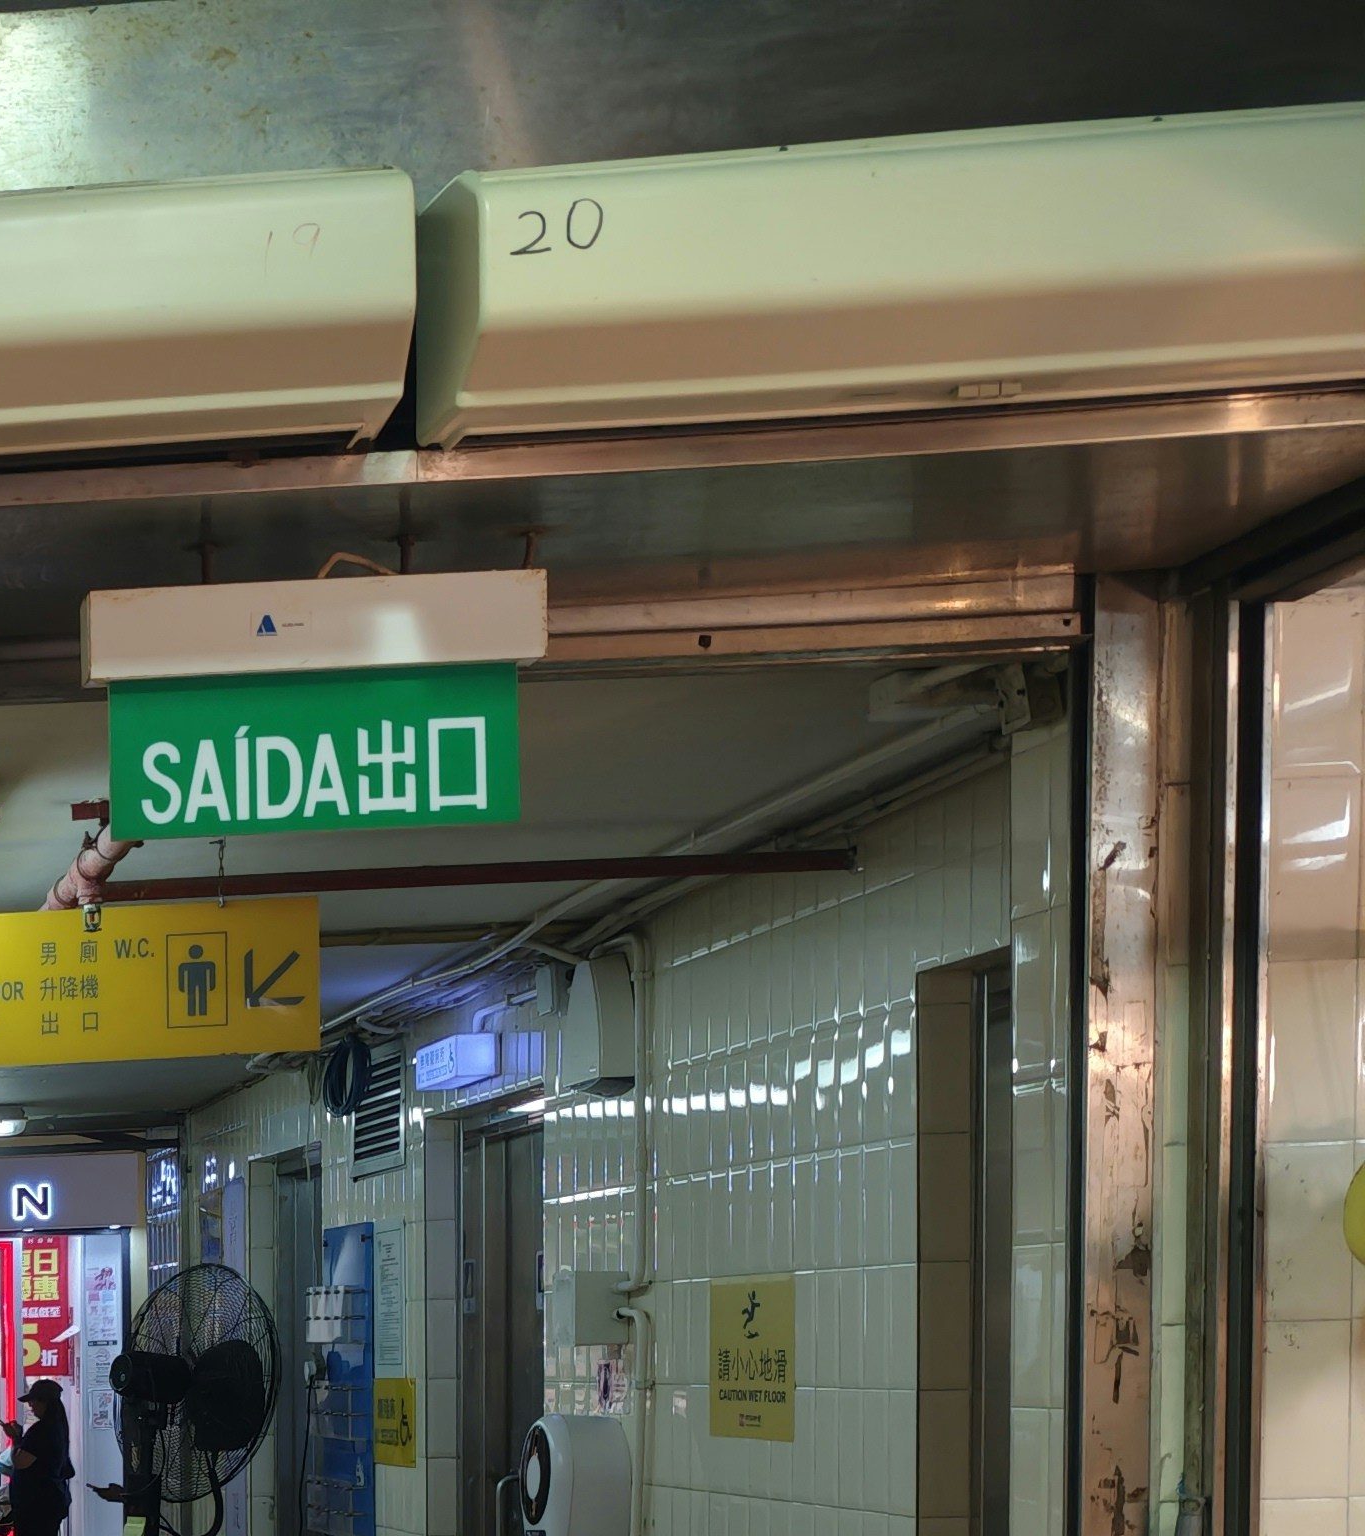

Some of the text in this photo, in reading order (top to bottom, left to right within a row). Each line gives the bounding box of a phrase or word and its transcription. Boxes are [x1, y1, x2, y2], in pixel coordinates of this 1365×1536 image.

[510, 198, 604, 256] 20
[141, 716, 488, 825] SAÍDA 出口
[114, 938, 155, 959] W.C.
[40, 974, 99, 1001] 升降機
[718, 1348, 788, 1383] 請小心地滑
[719, 1389, 786, 1403] CAUTION WET FLOOR
